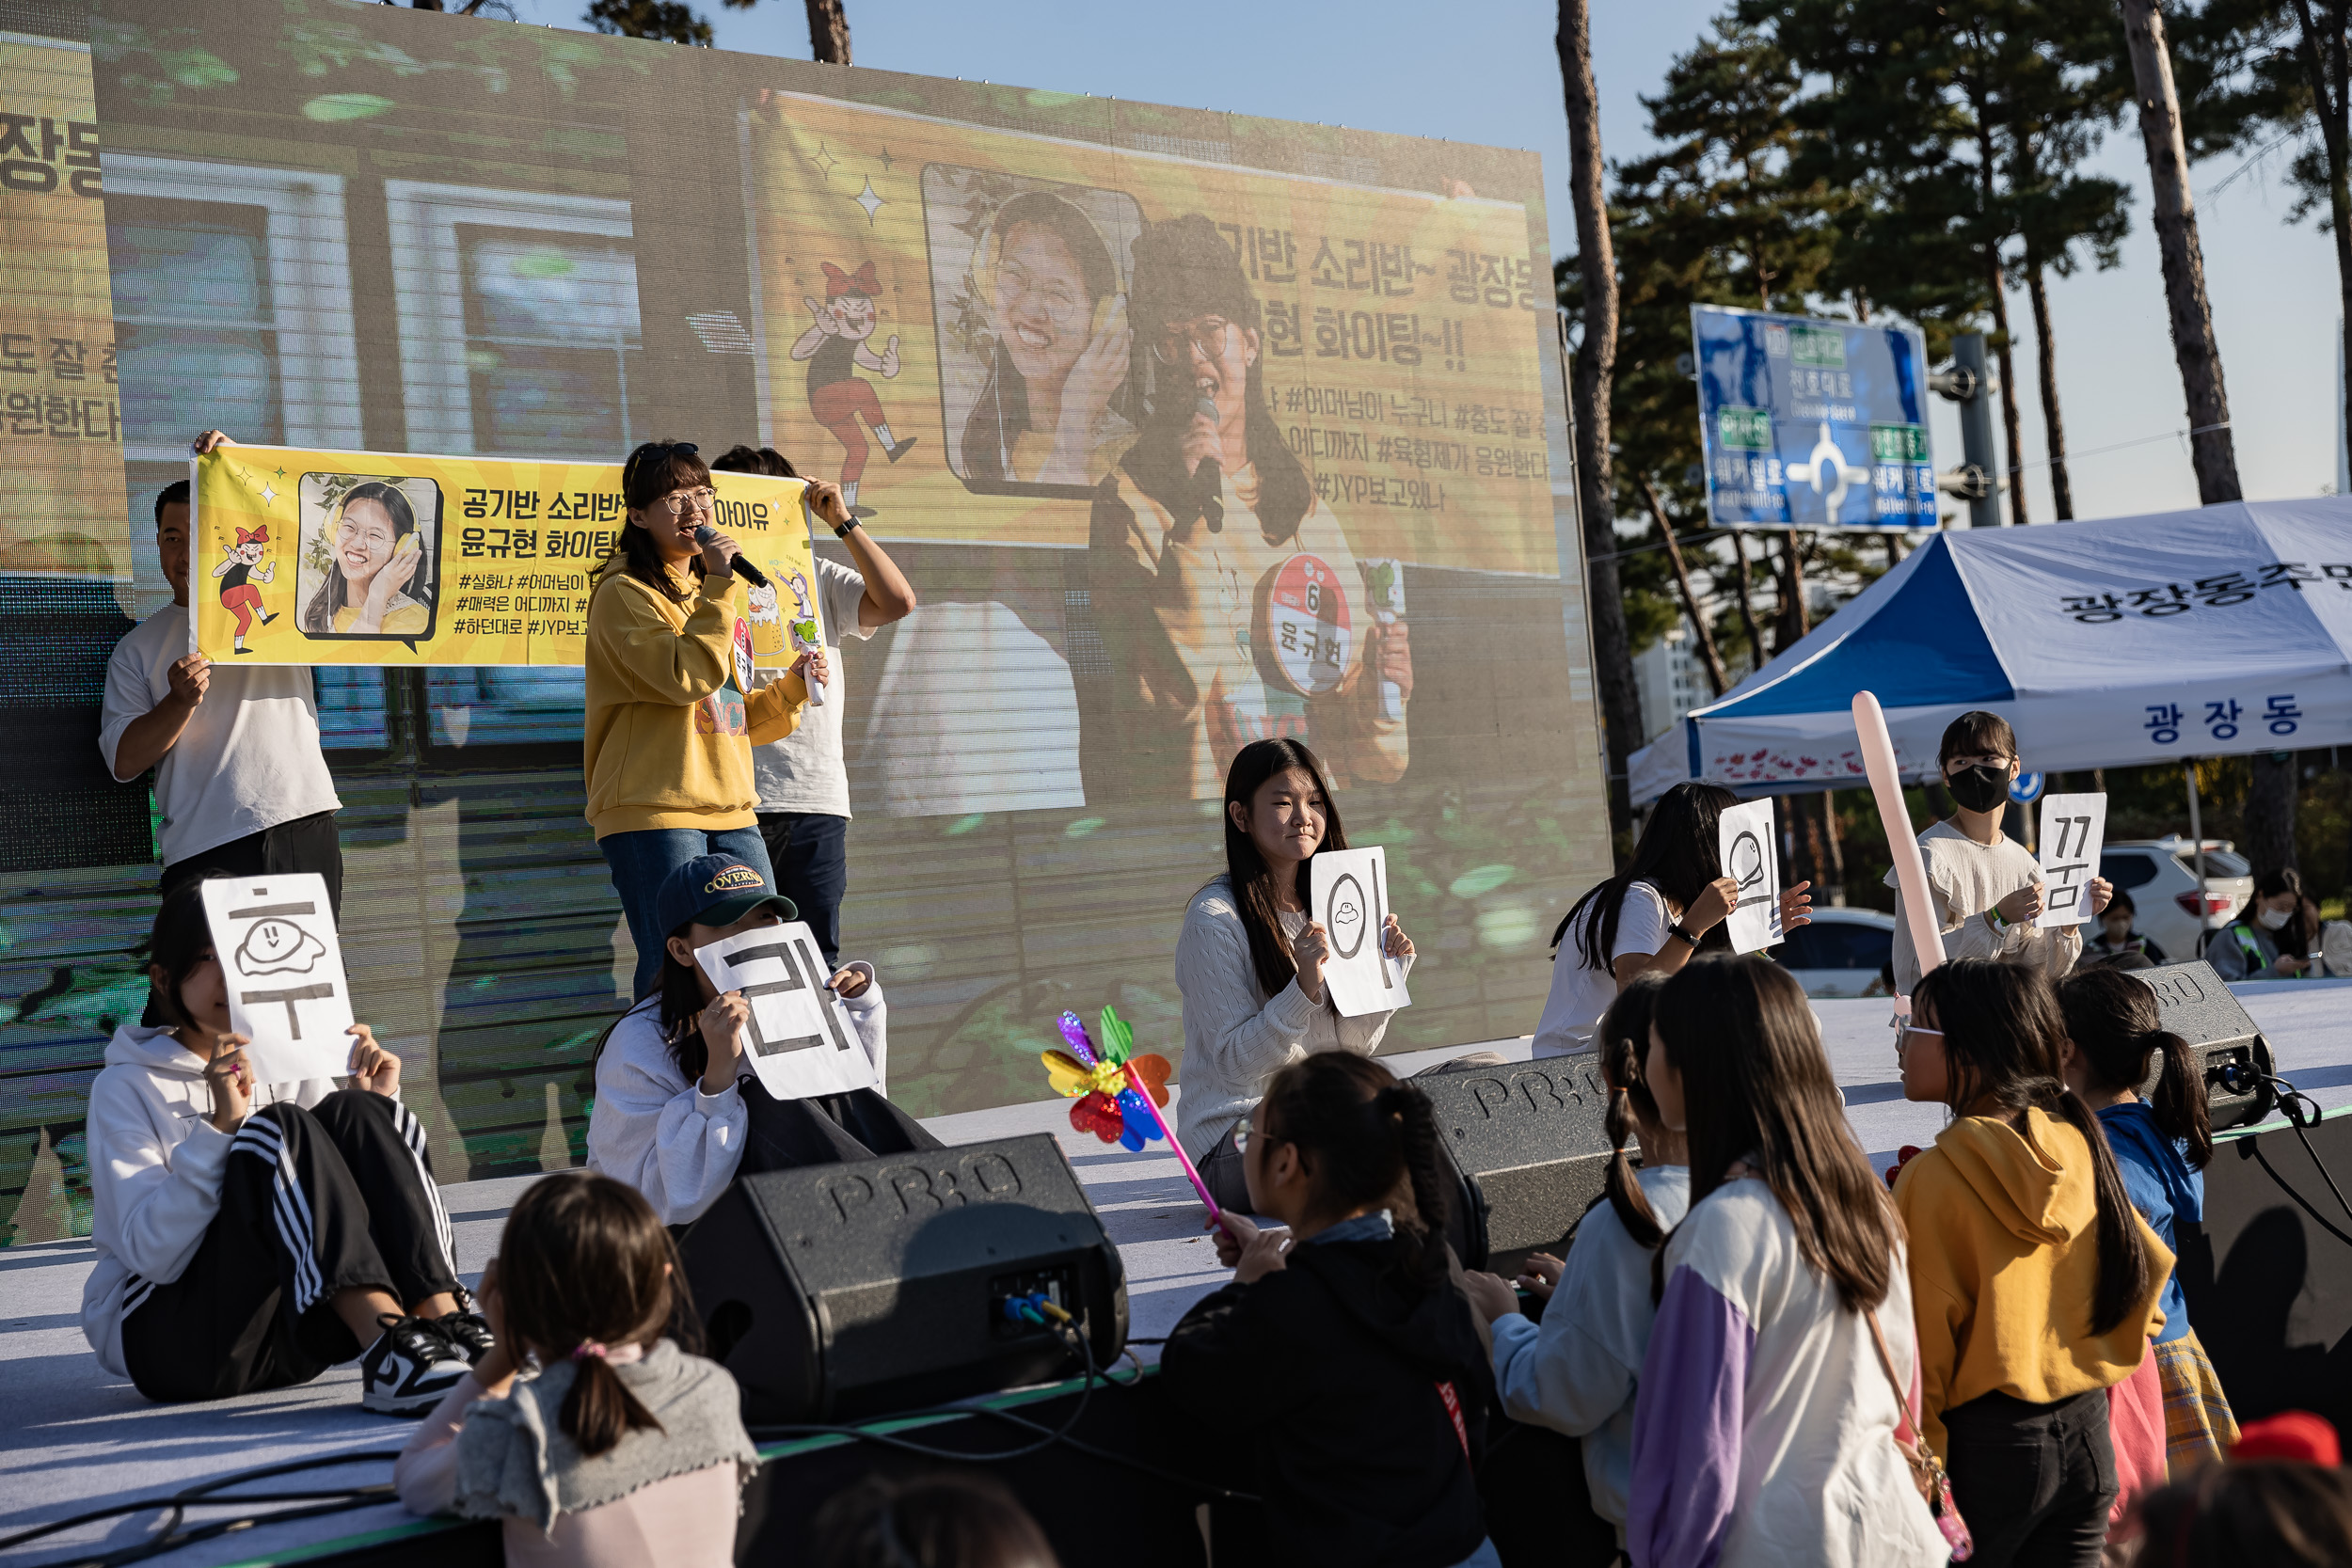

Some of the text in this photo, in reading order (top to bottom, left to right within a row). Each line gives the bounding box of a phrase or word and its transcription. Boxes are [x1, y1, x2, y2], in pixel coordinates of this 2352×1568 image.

[1217, 222, 1297, 283] 기반
[1263, 300, 1466, 372] 현 화이팅~!!
[0, 391, 122, 443] 원한다
[1286, 387, 1385, 422] #어머님이
[1391, 393, 1447, 429] 누구니
[1290, 426, 1370, 463] 어디까지
[1376, 436, 1470, 472] #육형제가
[1314, 472, 1447, 513] #JYP보고있나
[1872, 465, 1935, 499] 워커힐로
[463, 488, 540, 520] 공기반
[714, 499, 770, 531] 아이유
[461, 527, 537, 559] 윤규현
[456, 595, 510, 612] #매력은
[515, 595, 570, 613] 어디까지
[458, 574, 584, 591] #실화냐 #어머님이
[1308, 583, 1319, 611] 6
[453, 618, 523, 635] #하던대로
[1280, 620, 1341, 669] 윤규현
[2046, 816, 2091, 911] 꿈
[1327, 858, 1393, 990] 이
[723, 938, 850, 1057] 라
